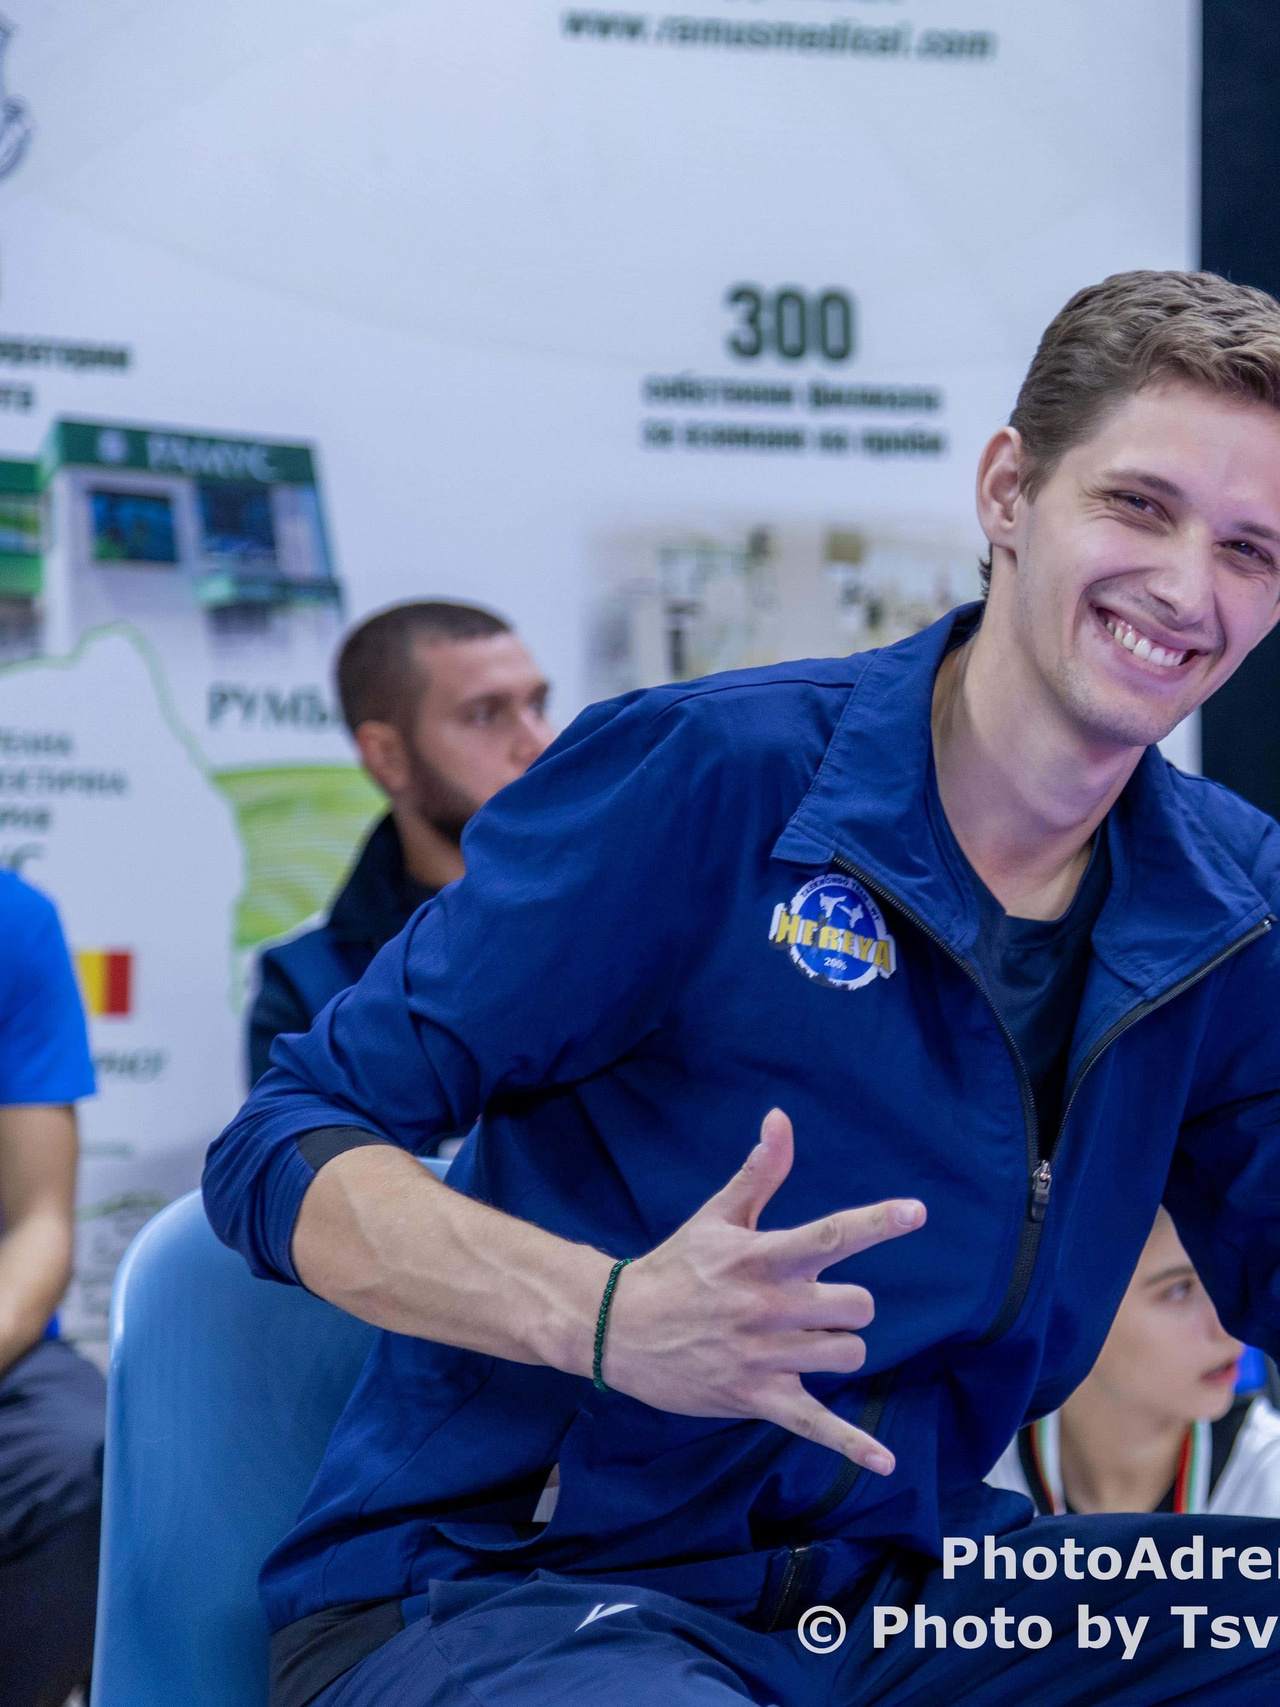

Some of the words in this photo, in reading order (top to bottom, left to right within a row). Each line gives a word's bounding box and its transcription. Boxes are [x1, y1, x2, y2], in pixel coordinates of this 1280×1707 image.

[563, 8, 998, 60] www.ramusmedical.com
[725, 284, 857, 362] 300
[775, 911, 891, 972] HEREYA
